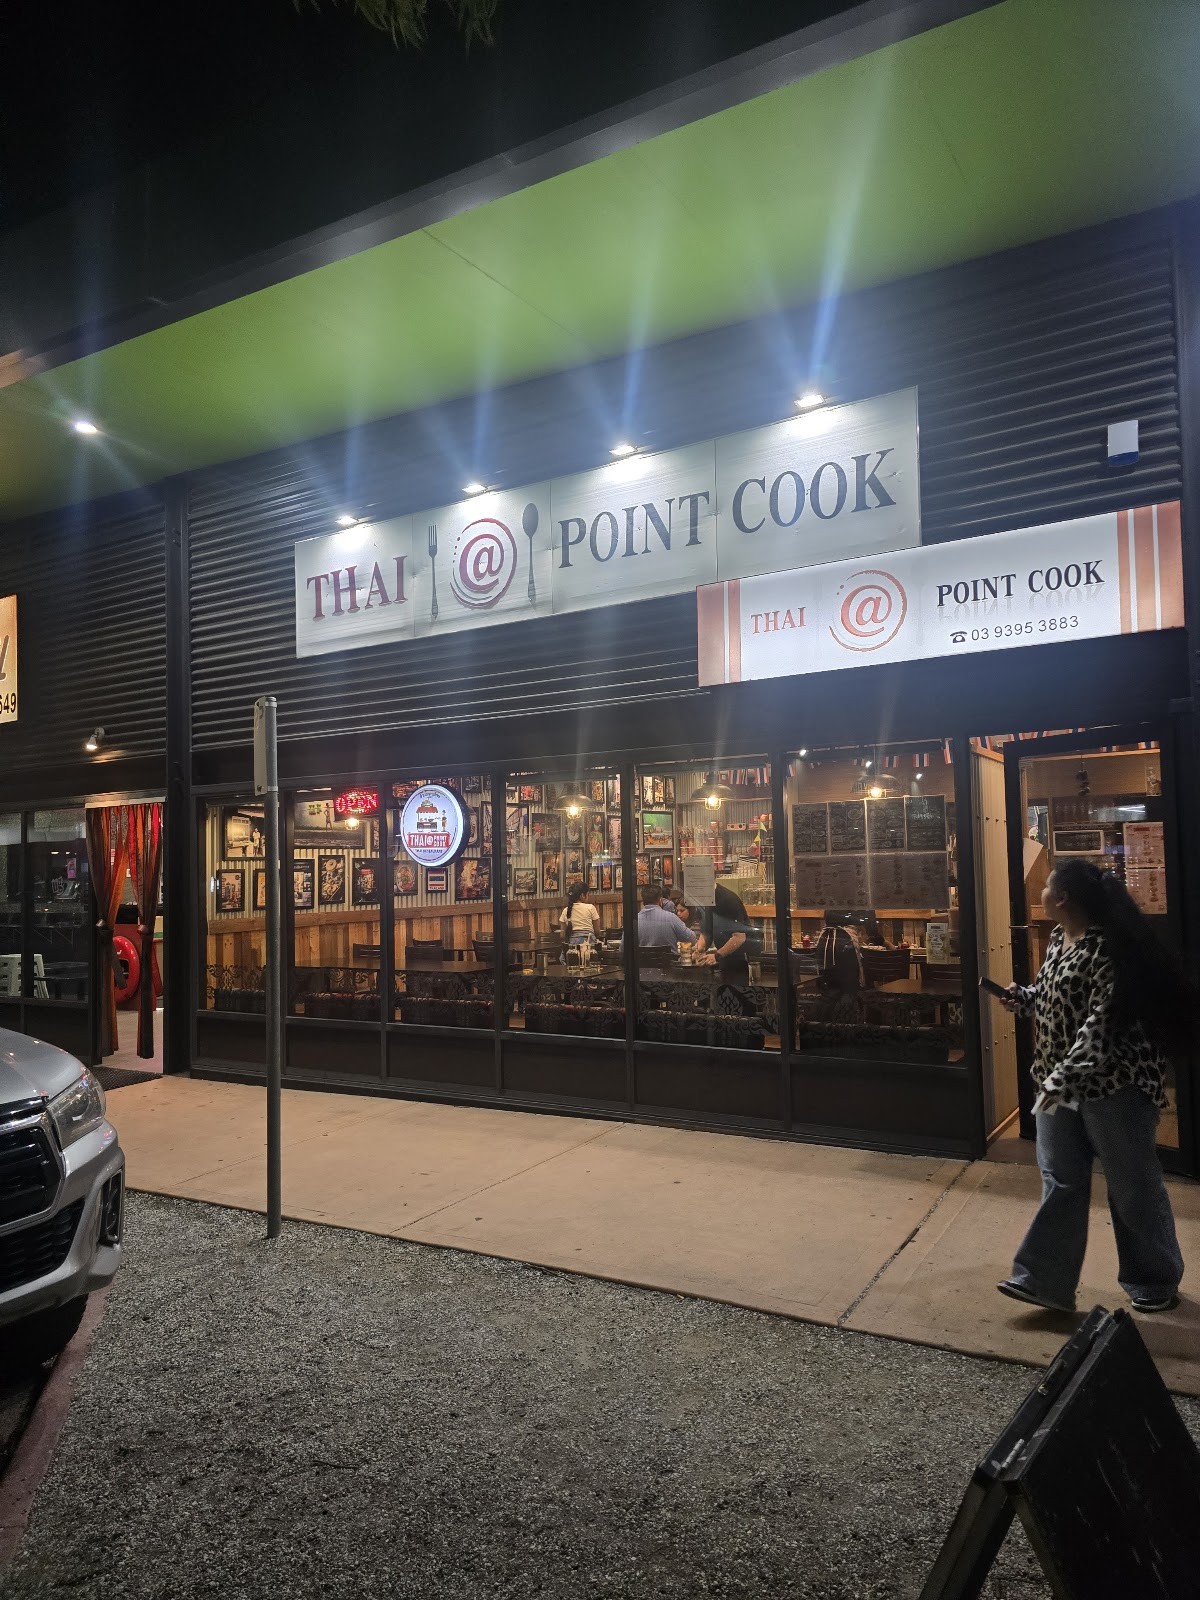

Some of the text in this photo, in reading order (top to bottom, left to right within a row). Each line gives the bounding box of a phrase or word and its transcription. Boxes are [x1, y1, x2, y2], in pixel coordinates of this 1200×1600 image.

[306, 555, 408, 622] THAI
[558, 491, 710, 569] POINT
[732, 448, 897, 534] COOK
[750, 606, 807, 635] THAI
[936, 573, 1017, 607] POINT
[1028, 560, 1106, 593] COOK
[970, 615, 1080, 642] 03 9395 3883
[335, 793, 378, 813] OPEN
